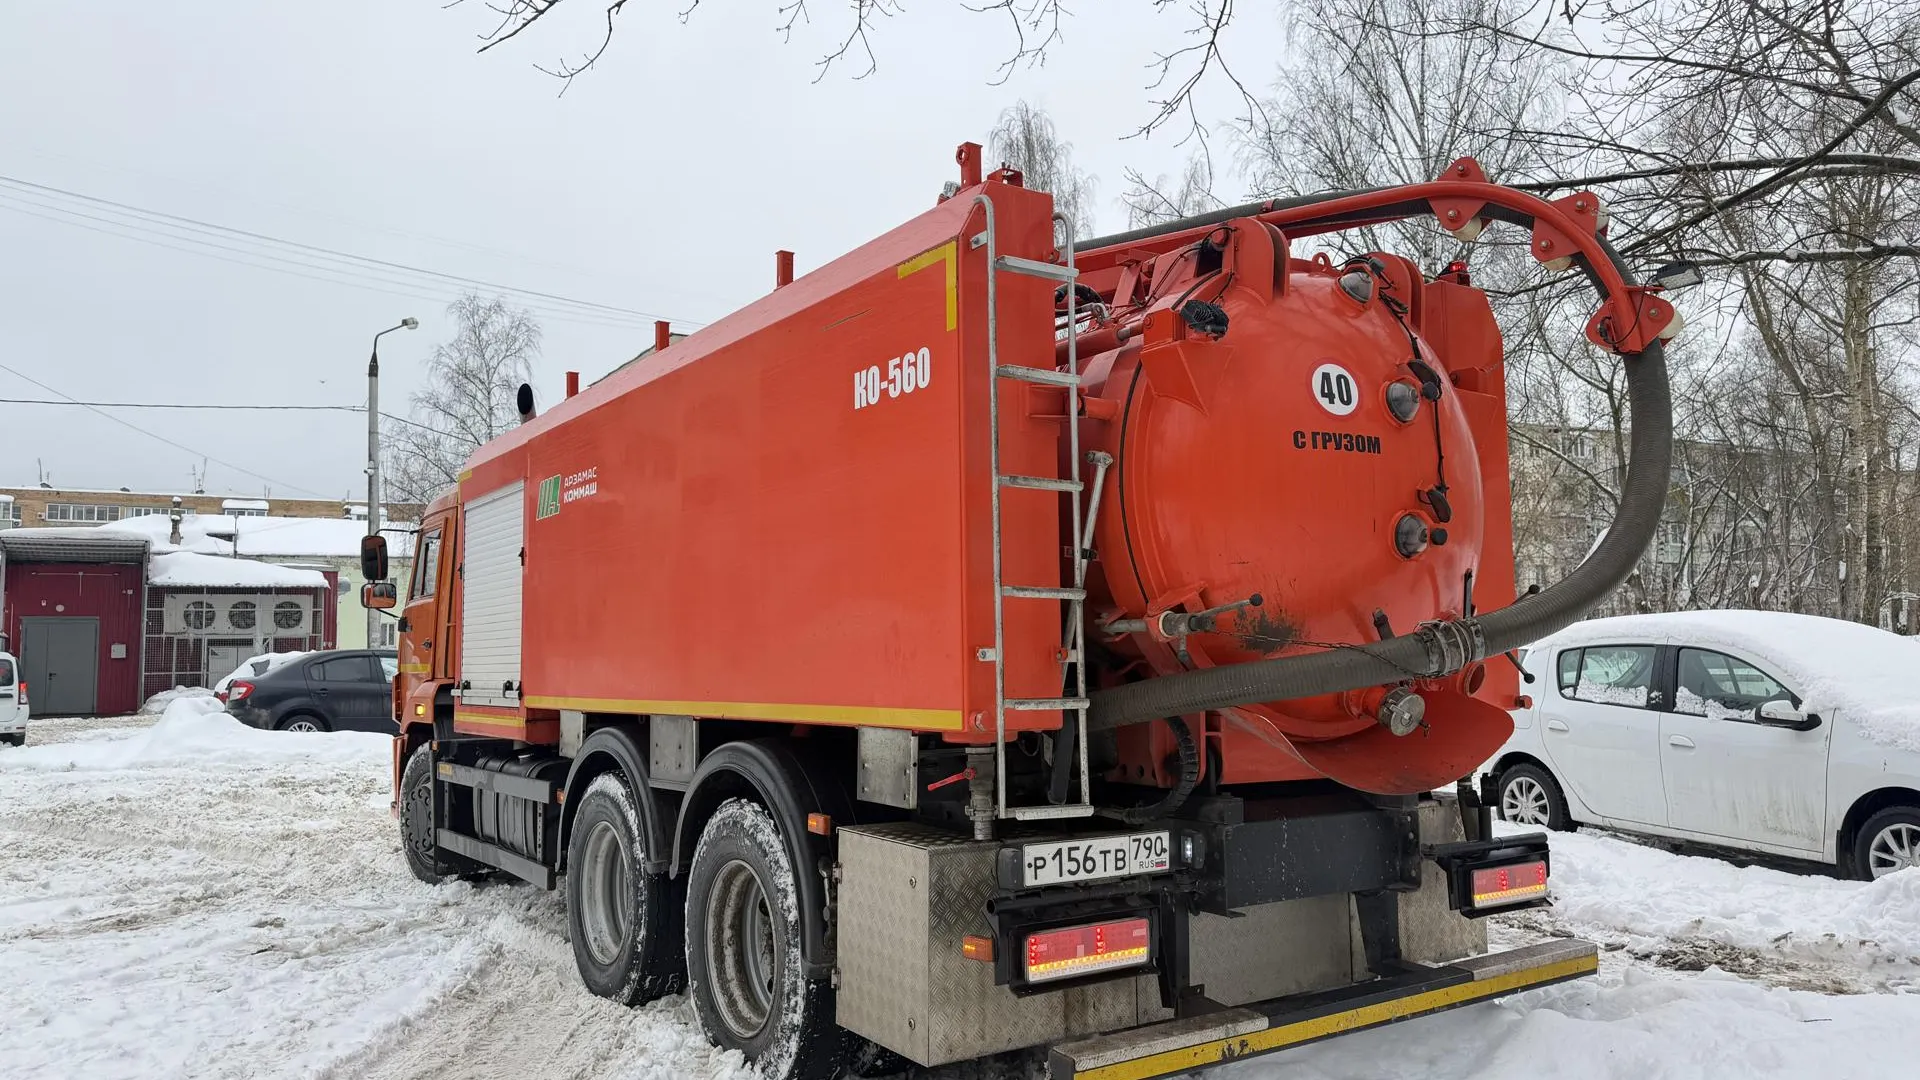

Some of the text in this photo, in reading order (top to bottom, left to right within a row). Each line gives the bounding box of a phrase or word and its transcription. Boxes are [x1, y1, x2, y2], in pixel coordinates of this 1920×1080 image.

[854, 347, 930, 410] КО-560
[1320, 372, 1353, 406] 40
[1293, 430, 1381, 454] С ГРУЗОМ
[563, 466, 597, 488] АРЗАМАС
[563, 481, 597, 504] КОММАШ
[1132, 835, 1164, 861] 790
[1139, 859, 1155, 869] RUS
